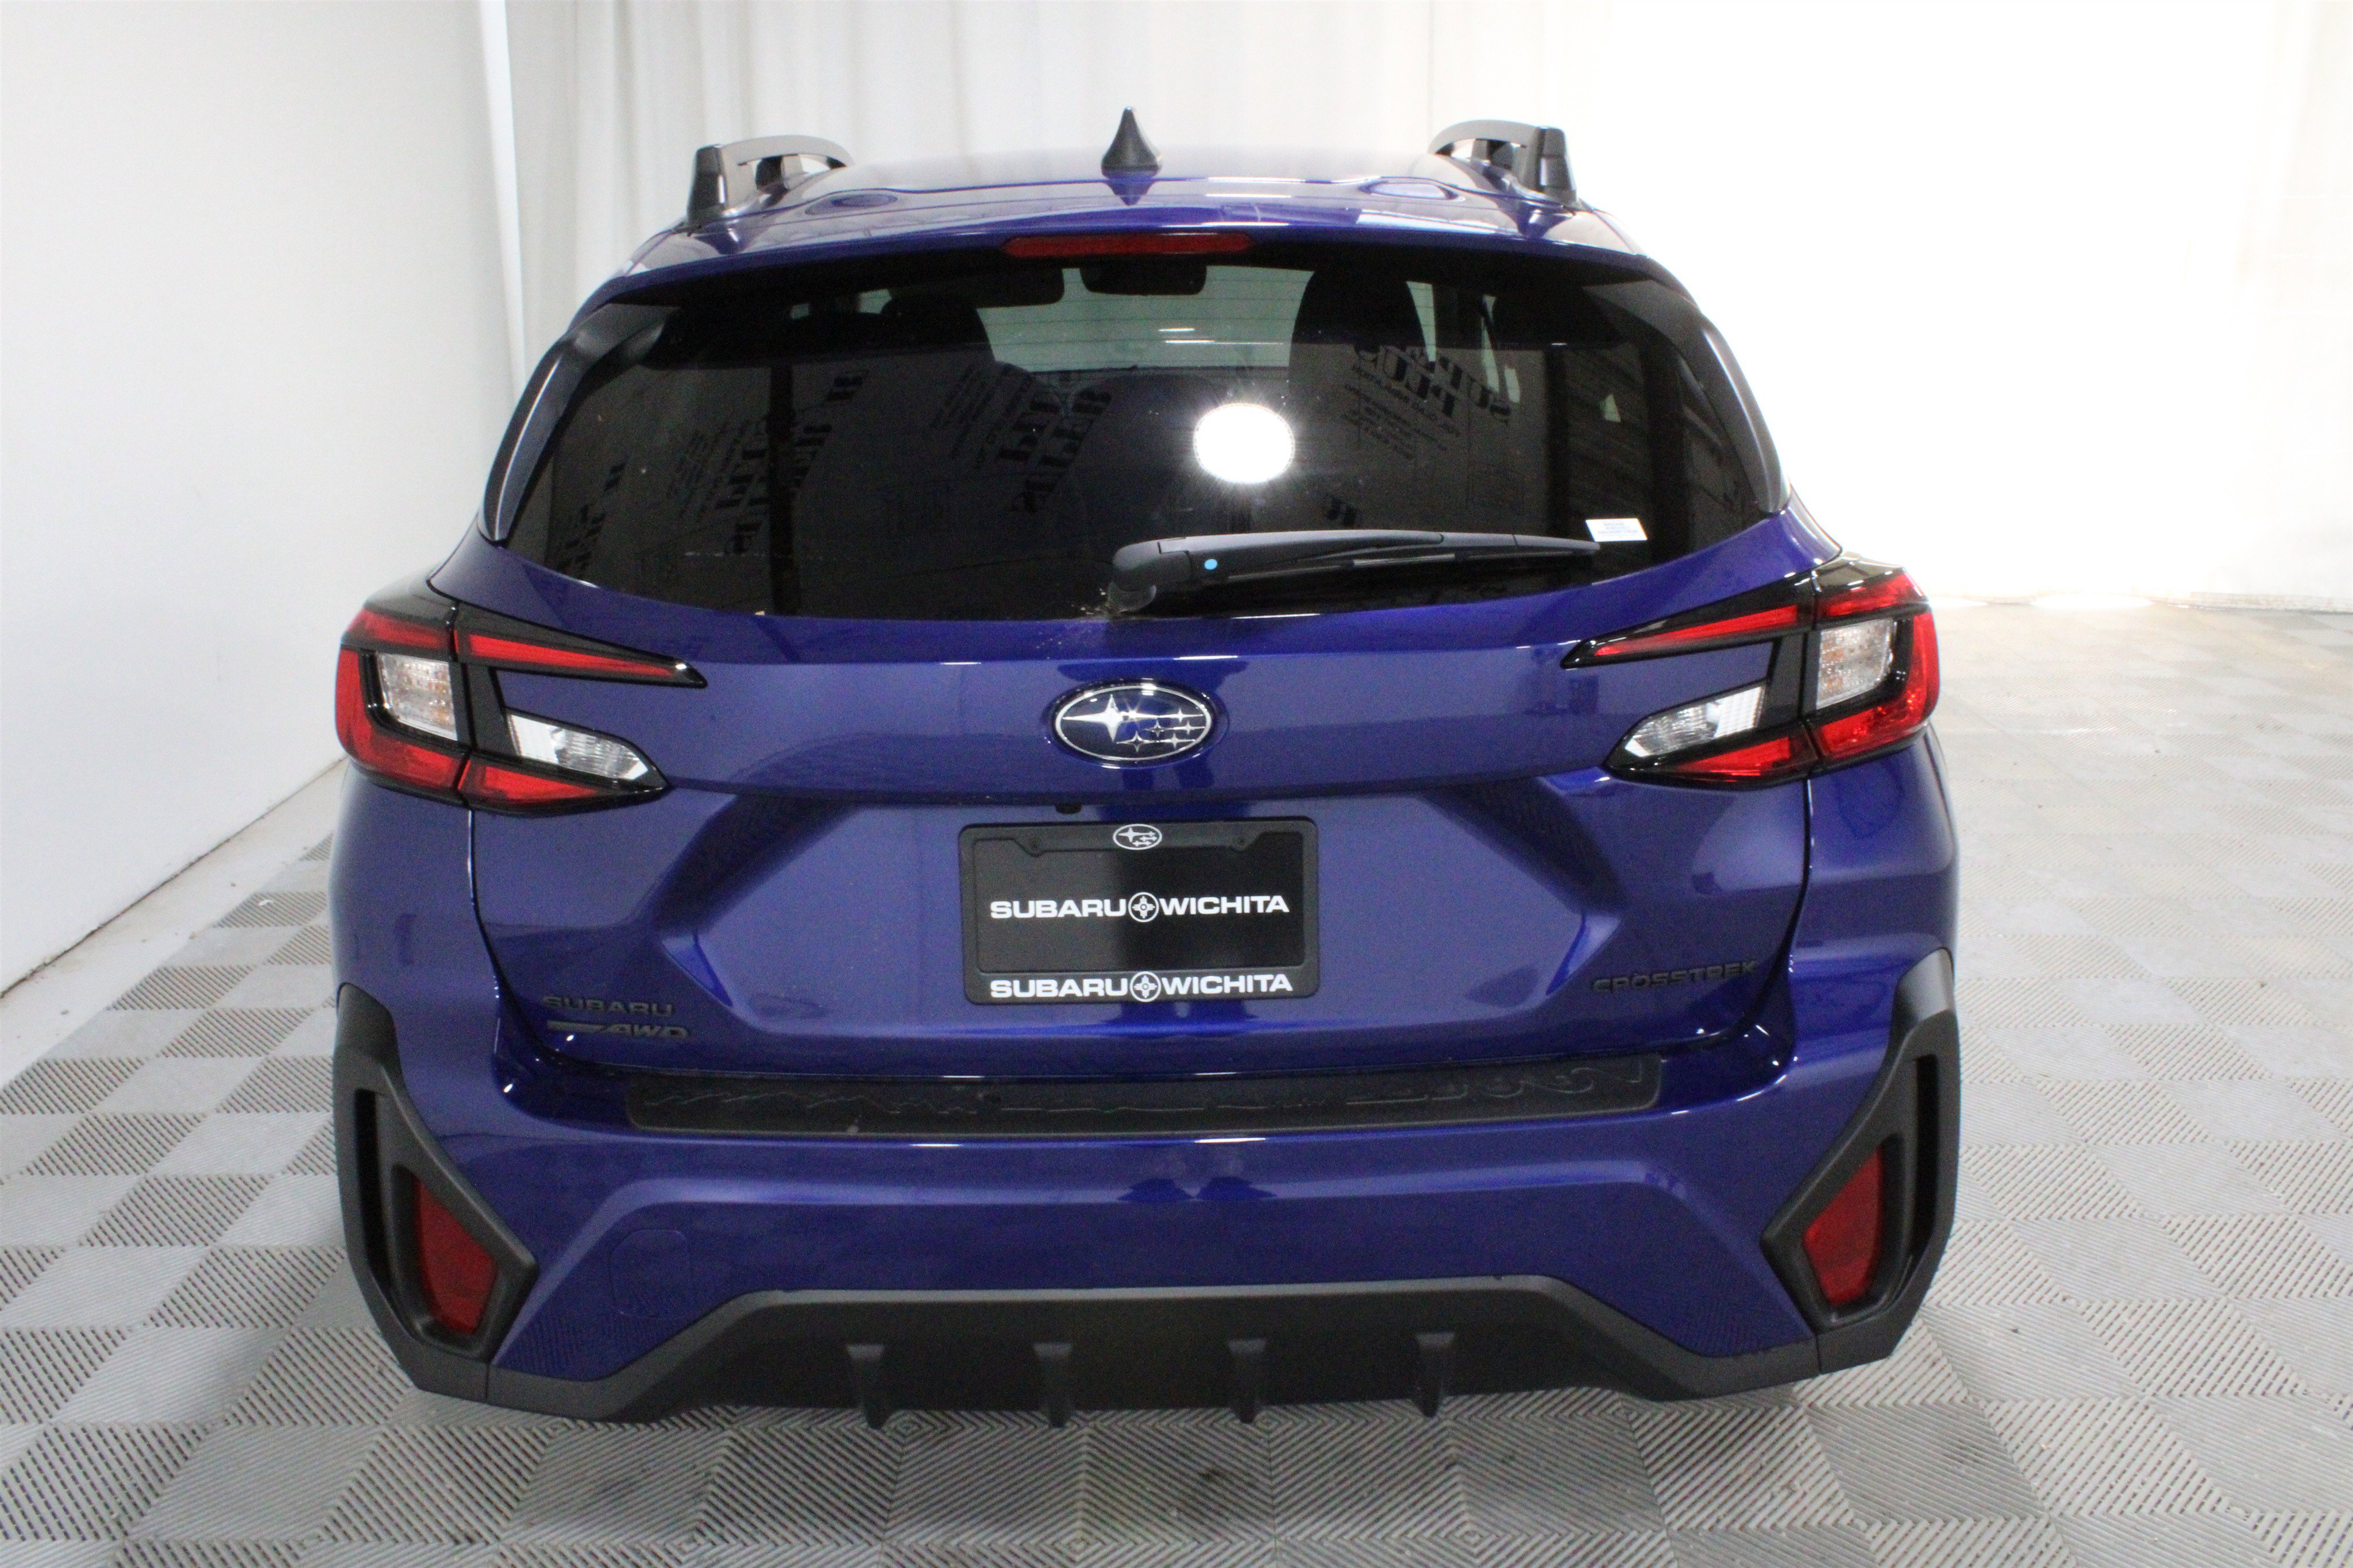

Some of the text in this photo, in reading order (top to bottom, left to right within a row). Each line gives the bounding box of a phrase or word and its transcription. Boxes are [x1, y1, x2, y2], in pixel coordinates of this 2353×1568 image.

[989, 895, 1291, 920] SUBARU WICHITA
[989, 973, 1294, 999] SUBARU WICHITA
[1591, 960, 1759, 994] CROSSTREK
[541, 995, 674, 1017] SUBARU
[601, 1022, 692, 1040] AWD
